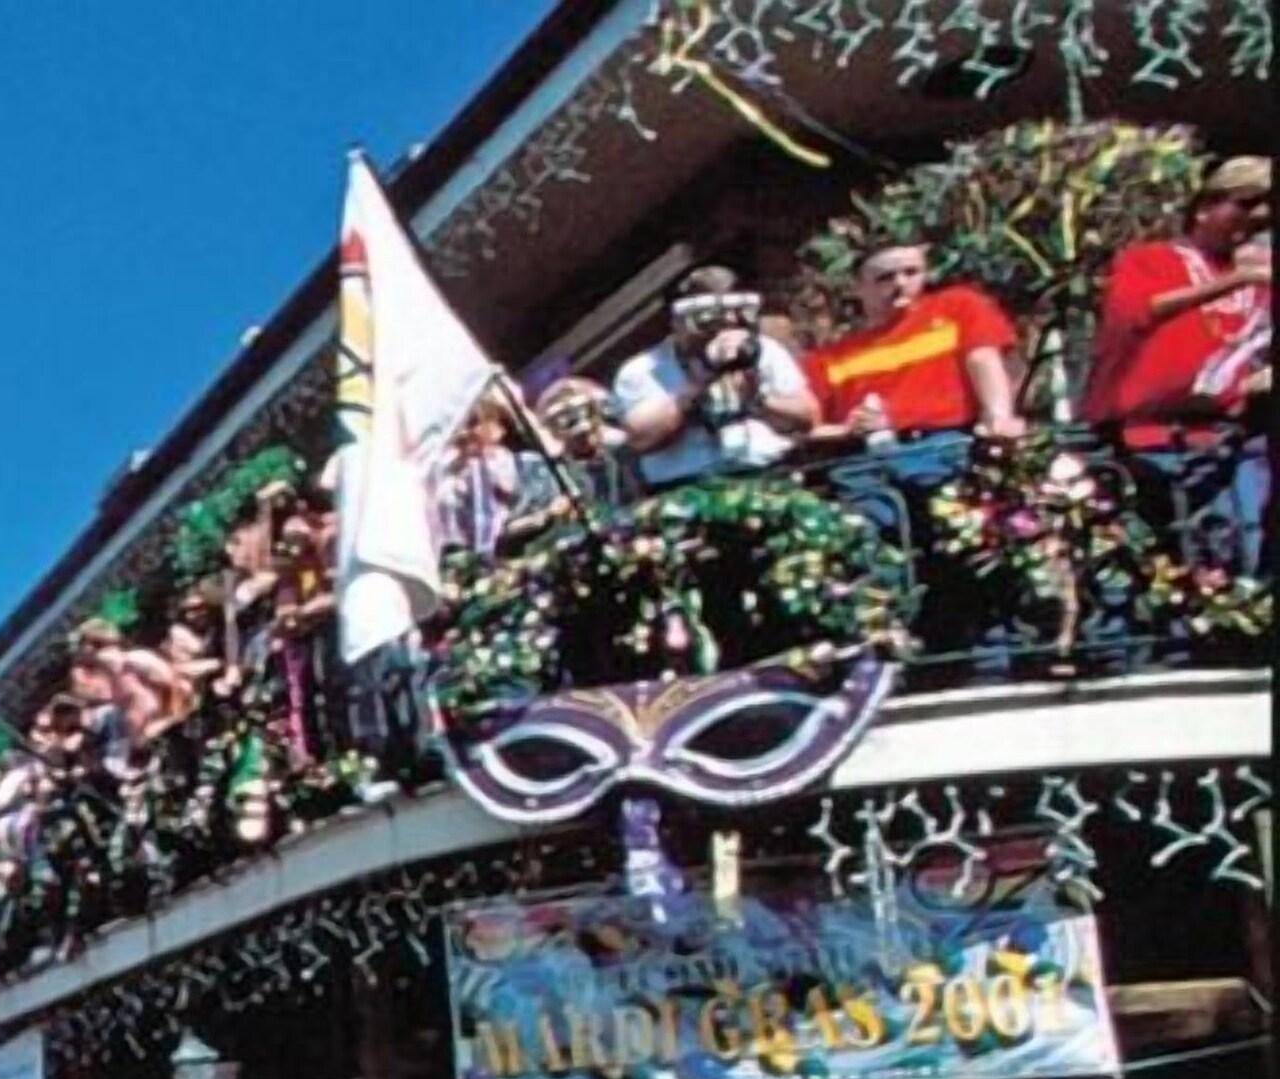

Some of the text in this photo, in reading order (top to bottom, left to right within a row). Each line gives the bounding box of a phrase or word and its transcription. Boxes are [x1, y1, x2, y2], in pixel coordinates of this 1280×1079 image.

[474, 1000, 680, 1076] MARDI
[699, 981, 884, 1060] GRAS
[899, 963, 1069, 1044] 2001
